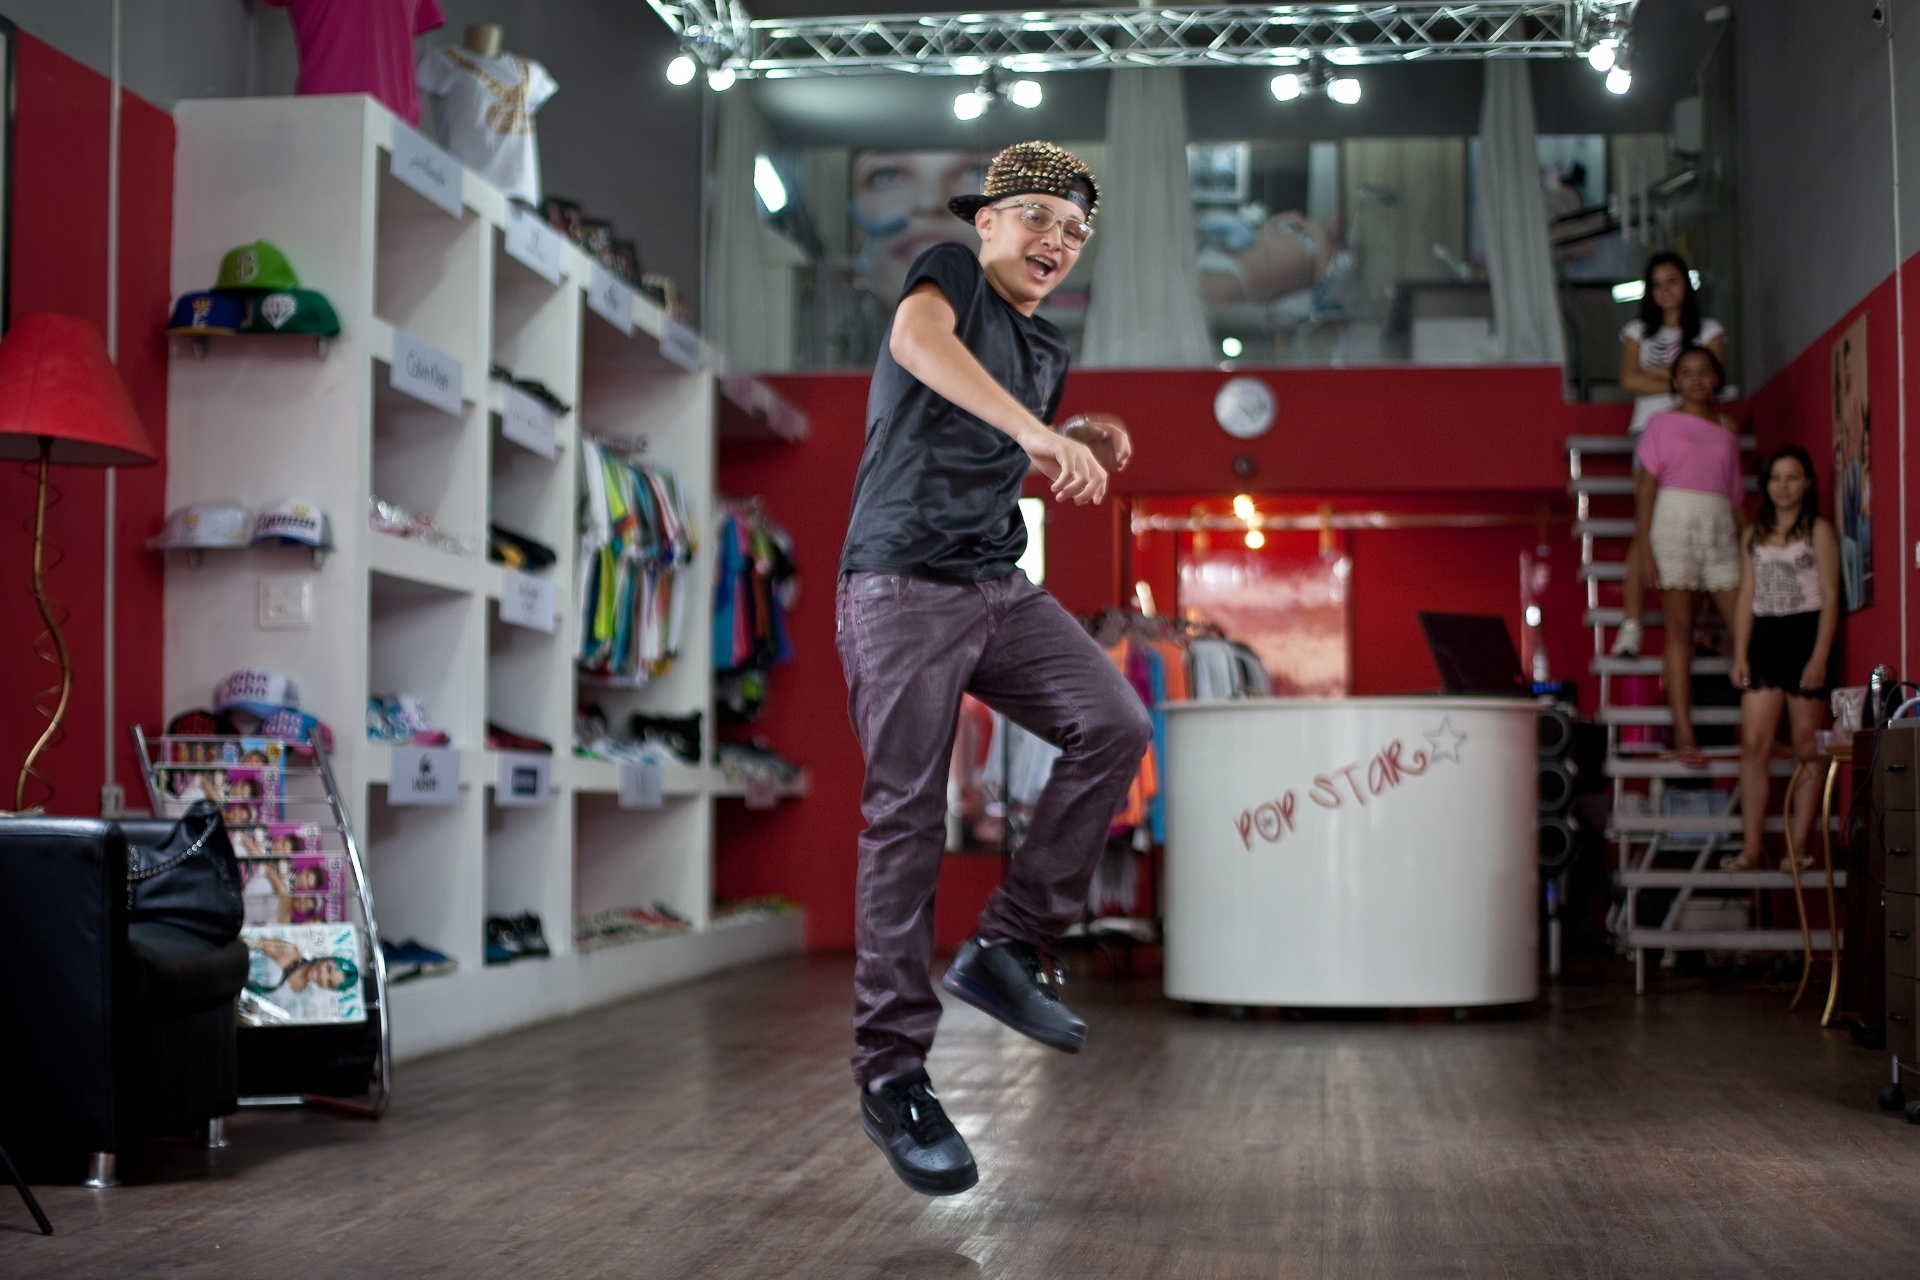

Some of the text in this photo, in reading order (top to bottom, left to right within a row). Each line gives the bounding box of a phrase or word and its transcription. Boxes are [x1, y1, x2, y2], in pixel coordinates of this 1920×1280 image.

[236, 251, 259, 284] B
[1233, 739, 1428, 852] POP STAR
